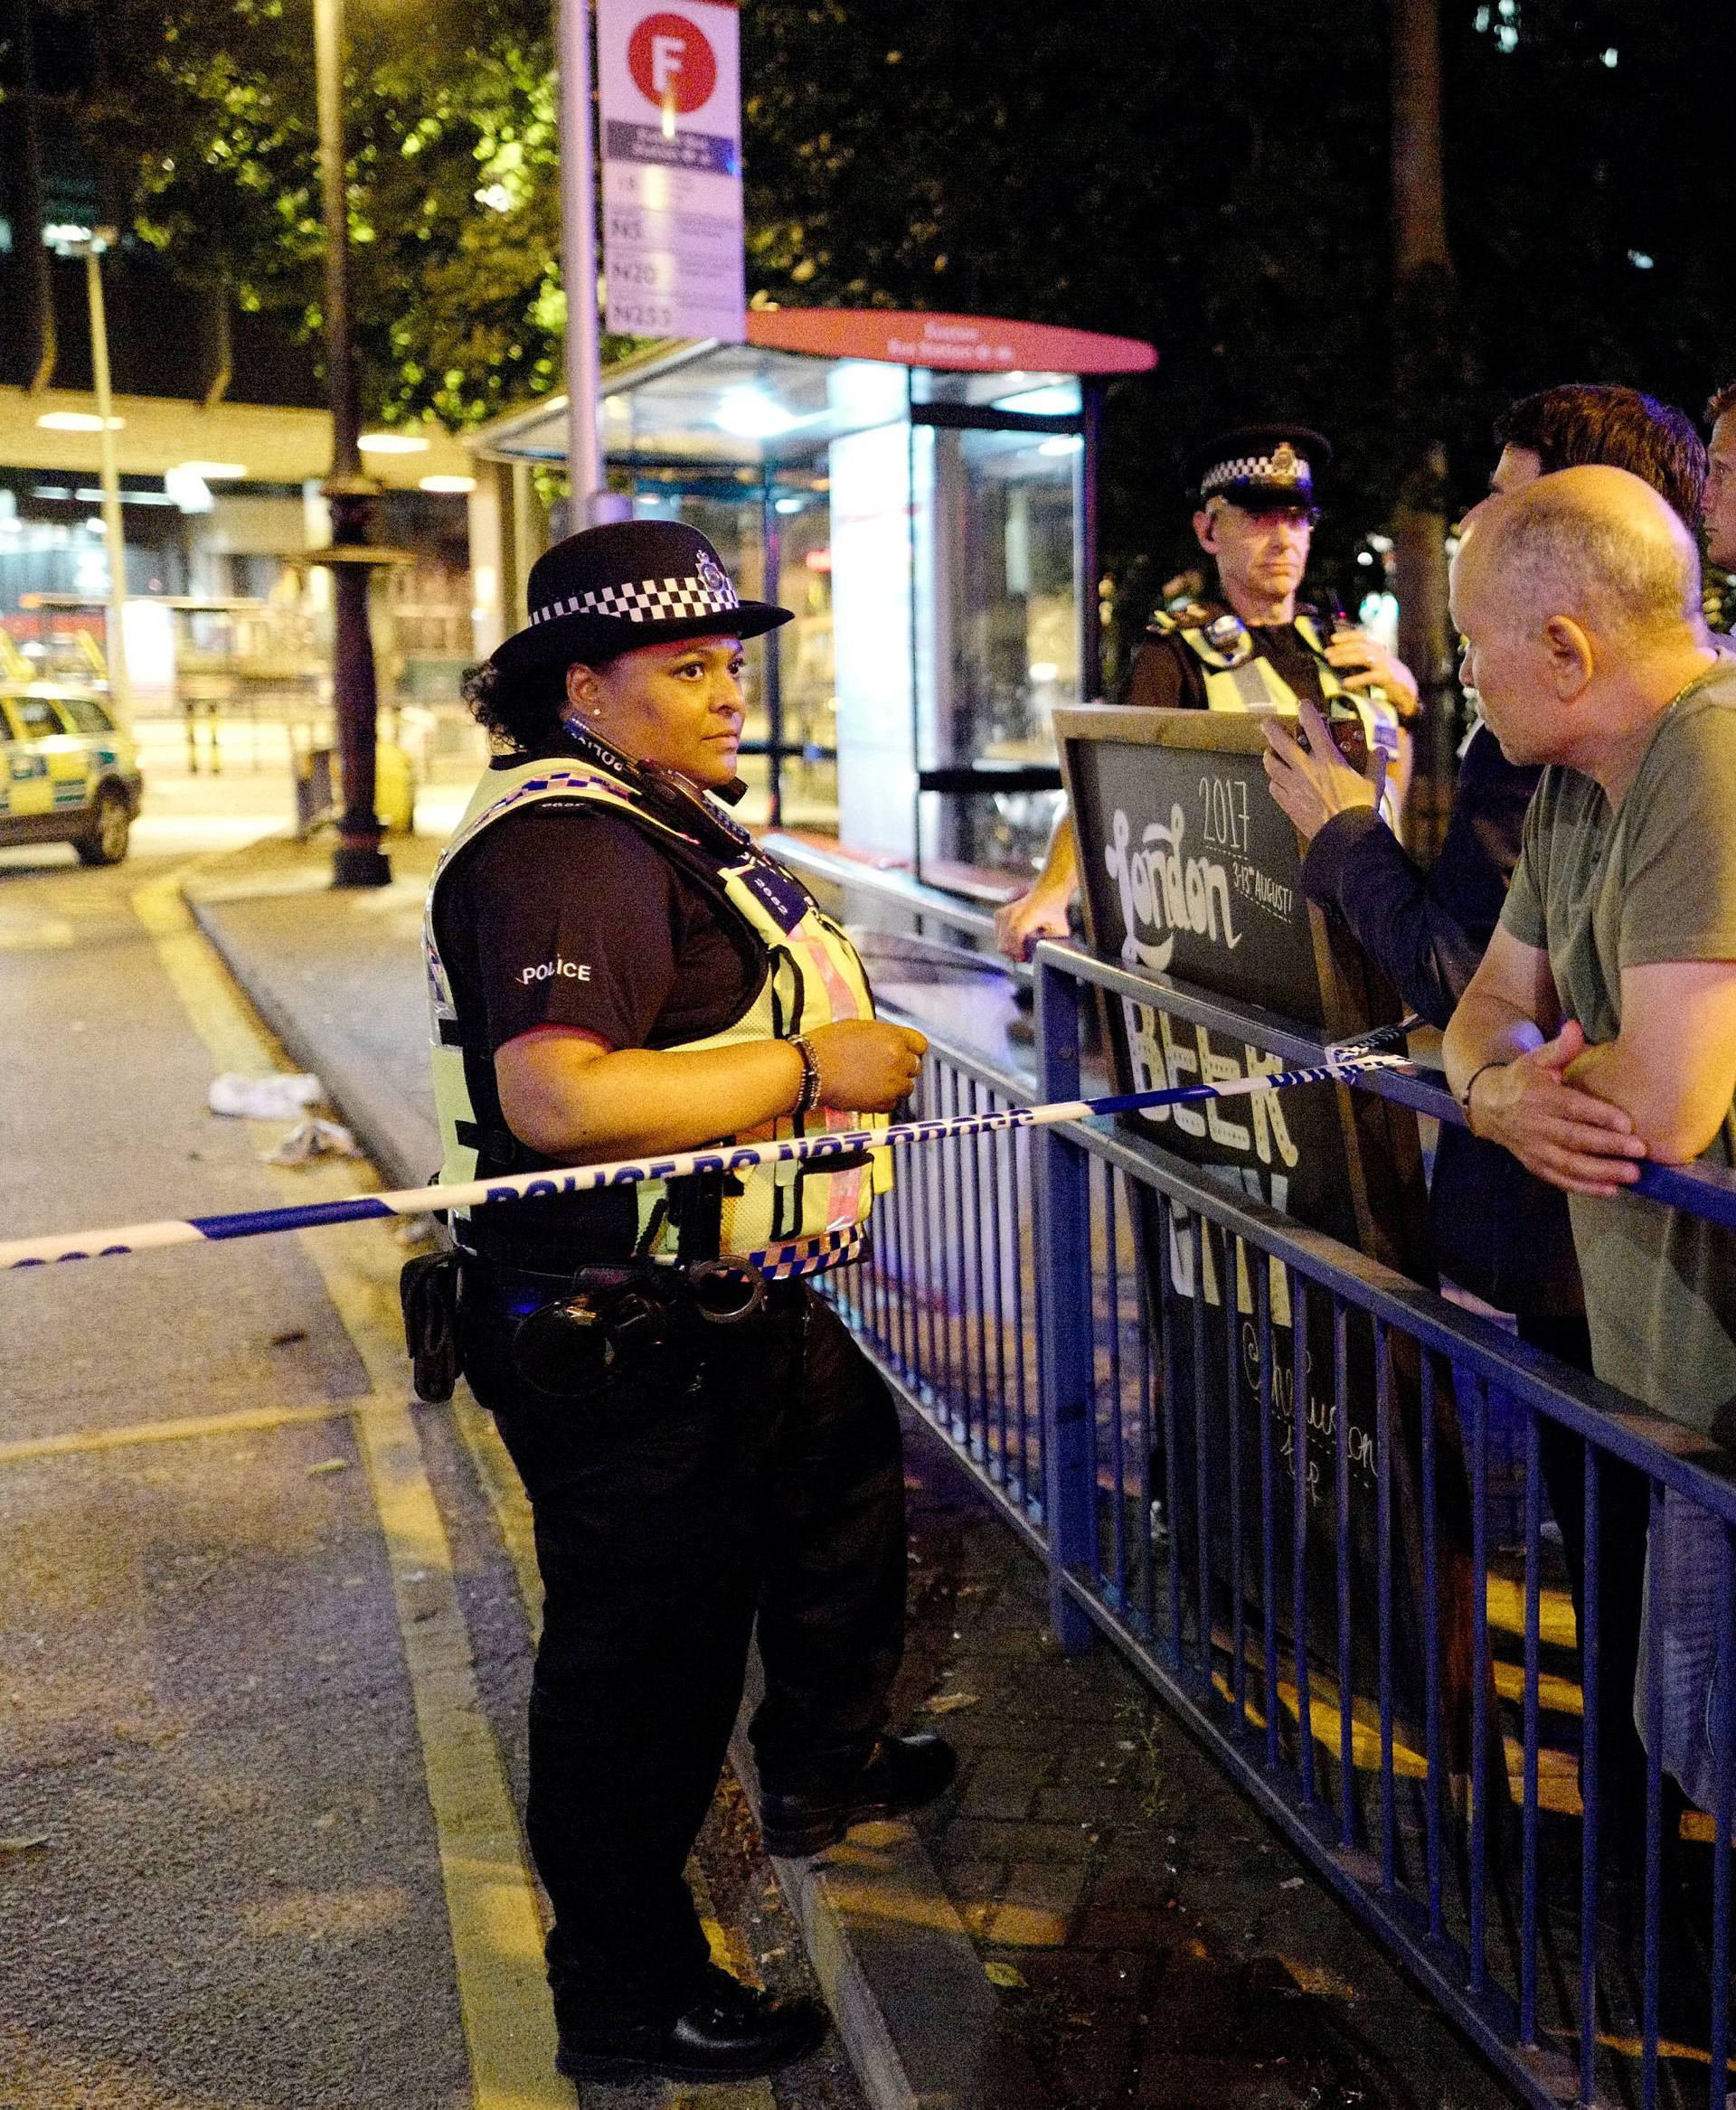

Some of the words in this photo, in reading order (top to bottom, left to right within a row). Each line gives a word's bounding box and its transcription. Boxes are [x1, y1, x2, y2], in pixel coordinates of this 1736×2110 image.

[652, 34, 686, 93] F
[1198, 777, 1250, 852] 2017
[1105, 804, 1242, 971] London
[523, 954, 591, 984] POLICE
[1121, 994, 1298, 1167] BEER
[778, 1131, 873, 1159] NOT
